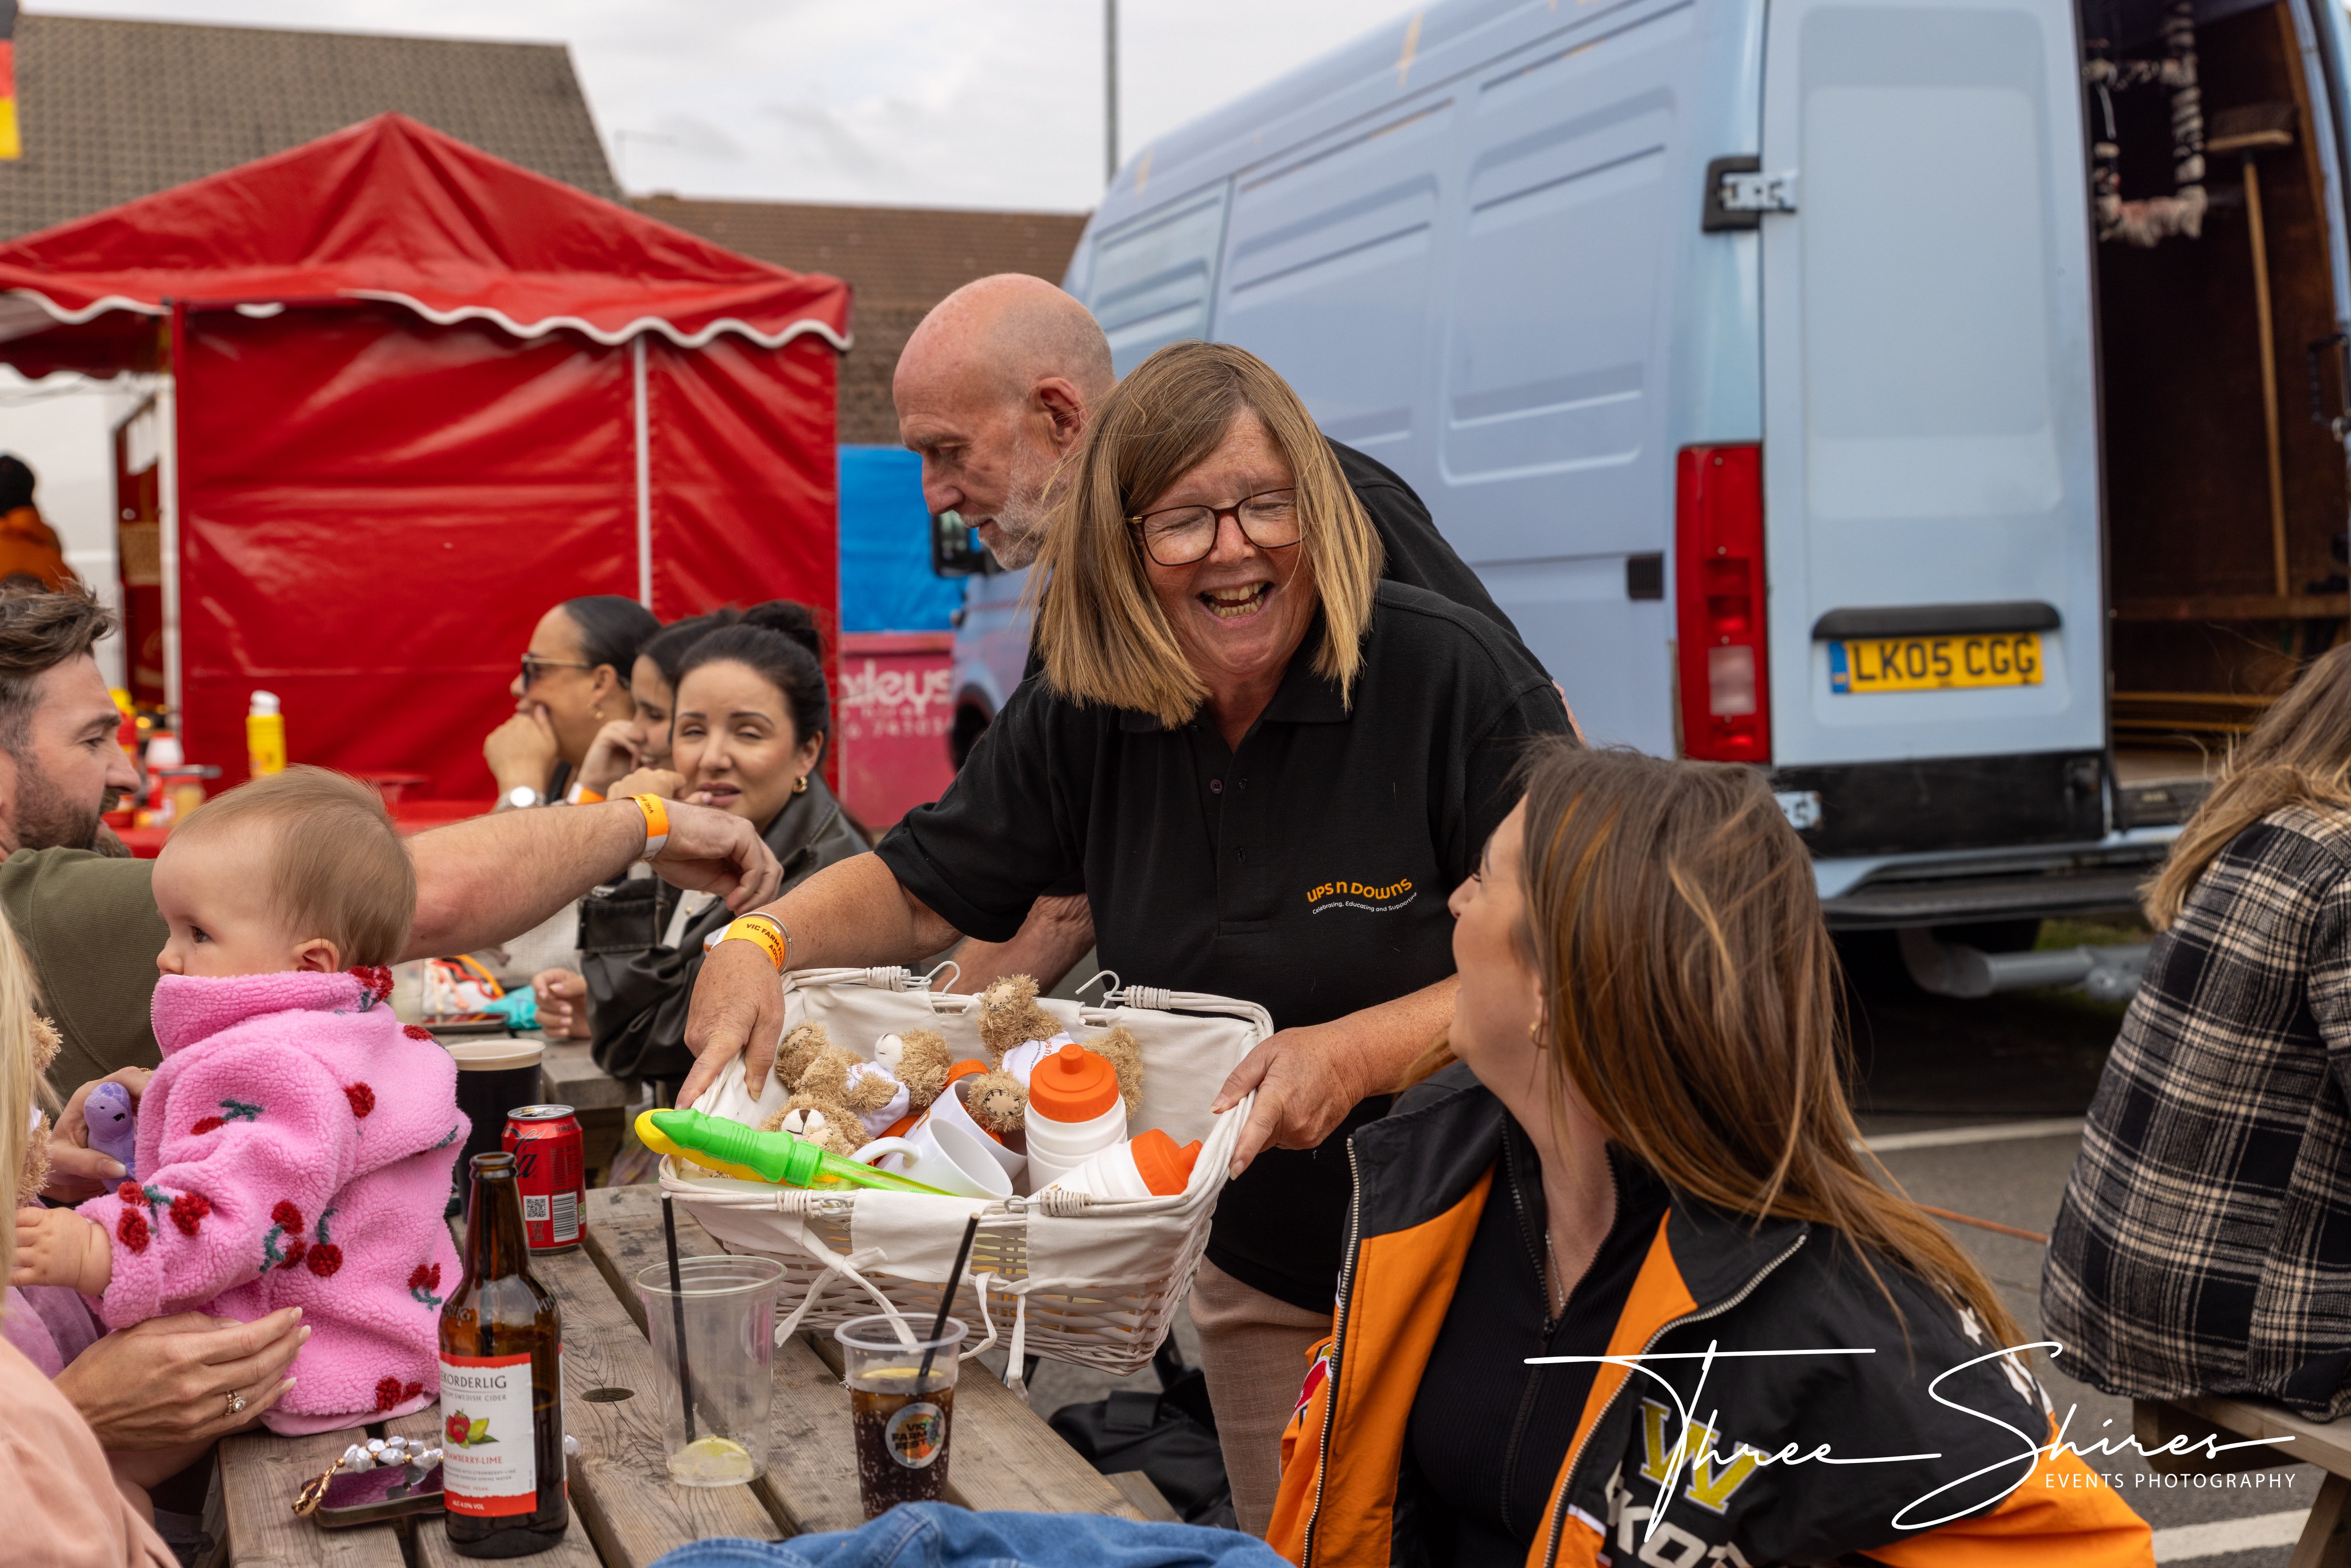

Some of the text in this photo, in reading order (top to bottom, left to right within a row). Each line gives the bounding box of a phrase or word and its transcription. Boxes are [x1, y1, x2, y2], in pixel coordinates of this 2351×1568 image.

[1853, 636, 2035, 682] LK05 CGG
[1306, 883, 1334, 903] UPS
[1345, 901, 1375, 912] Educating
[761, 928, 779, 947] FARM
[455, 1392, 481, 1402] SWEDISH
